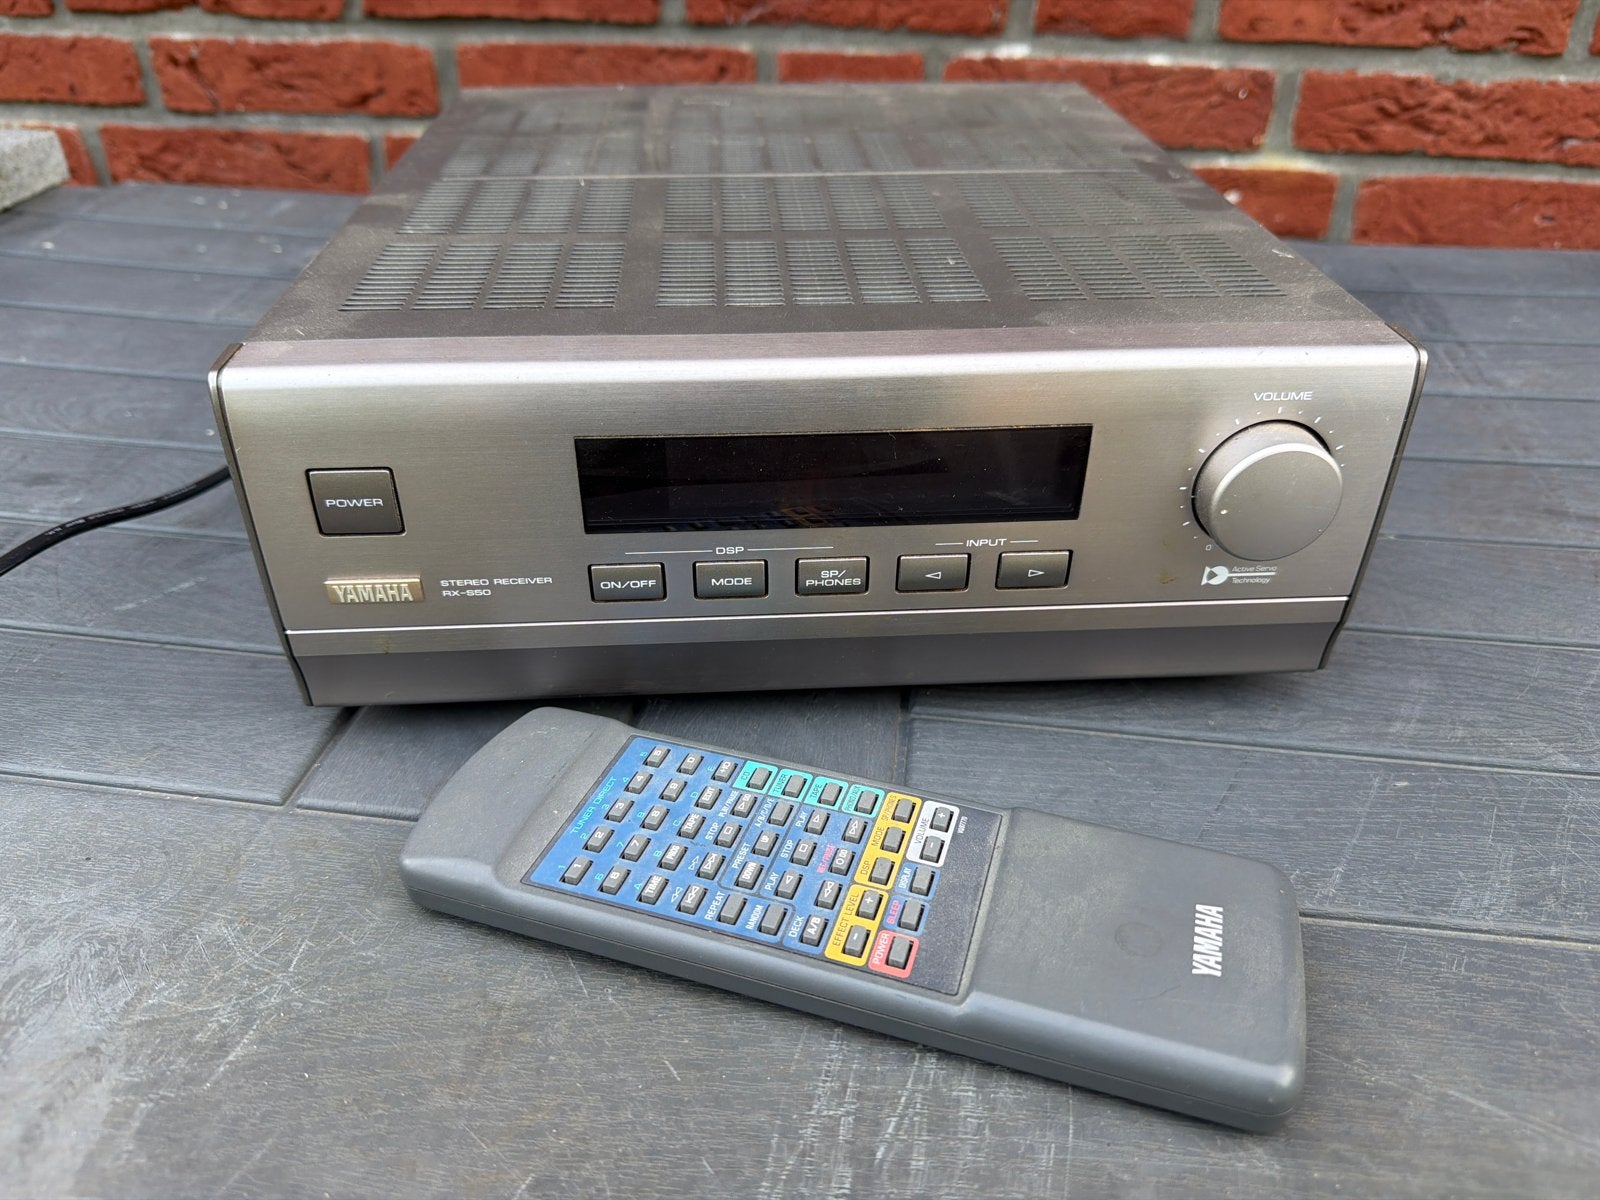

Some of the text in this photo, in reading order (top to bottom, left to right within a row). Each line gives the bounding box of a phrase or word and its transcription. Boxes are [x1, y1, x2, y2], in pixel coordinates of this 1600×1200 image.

[1254, 391, 1313, 401] VOLUME
[325, 497, 383, 508] POWER
[716, 546, 745, 555] DSP
[966, 537, 1007, 548] INPUT
[440, 576, 553, 587] STEREO RECEIVER
[711, 575, 753, 587] MODE
[806, 577, 861, 588] PHONES
[820, 569, 848, 579] SP/
[442, 589, 491, 597] RX-S50
[600, 578, 657, 590] ON/OFF
[333, 584, 413, 603] YAMAHA
[740, 771, 750, 780] CD
[772, 773, 788, 793] TUNER
[701, 786, 715, 800] EDIT
[809, 783, 822, 798] TAPE
[570, 775, 618, 834] TUNER DIRECT
[718, 790, 739, 817] PLAY/PAUSE
[753, 797, 775, 827] A/B/C/D/E
[881, 794, 897, 821] SP/PHONES
[683, 813, 699, 830] TAPE
[795, 811, 808, 826] PLAY
[704, 822, 720, 840] STOP
[760, 834, 770, 842] UP
[870, 826, 884, 846] MODE
[914, 816, 929, 844] VOLUME
[665, 844, 680, 859] PROG
[731, 842, 751, 868] PRESET
[780, 839, 795, 858] STOP
[741, 861, 757, 879] DOWN
[859, 860, 872, 875] DSP
[644, 875, 662, 894] TIME
[764, 872, 779, 890] PLAY
[898, 867, 912, 888] DISPLAY
[704, 891, 725, 920] REPEAT
[886, 899, 902, 924] SLEEP
[745, 904, 763, 929] RANDOM
[806, 916, 821, 934] A/B
[832, 892, 859, 946] EFFECT LEVEL
[788, 915, 804, 937] DECK
[872, 932, 890, 964] POWER
[1192, 904, 1223, 977] YAMAHA
